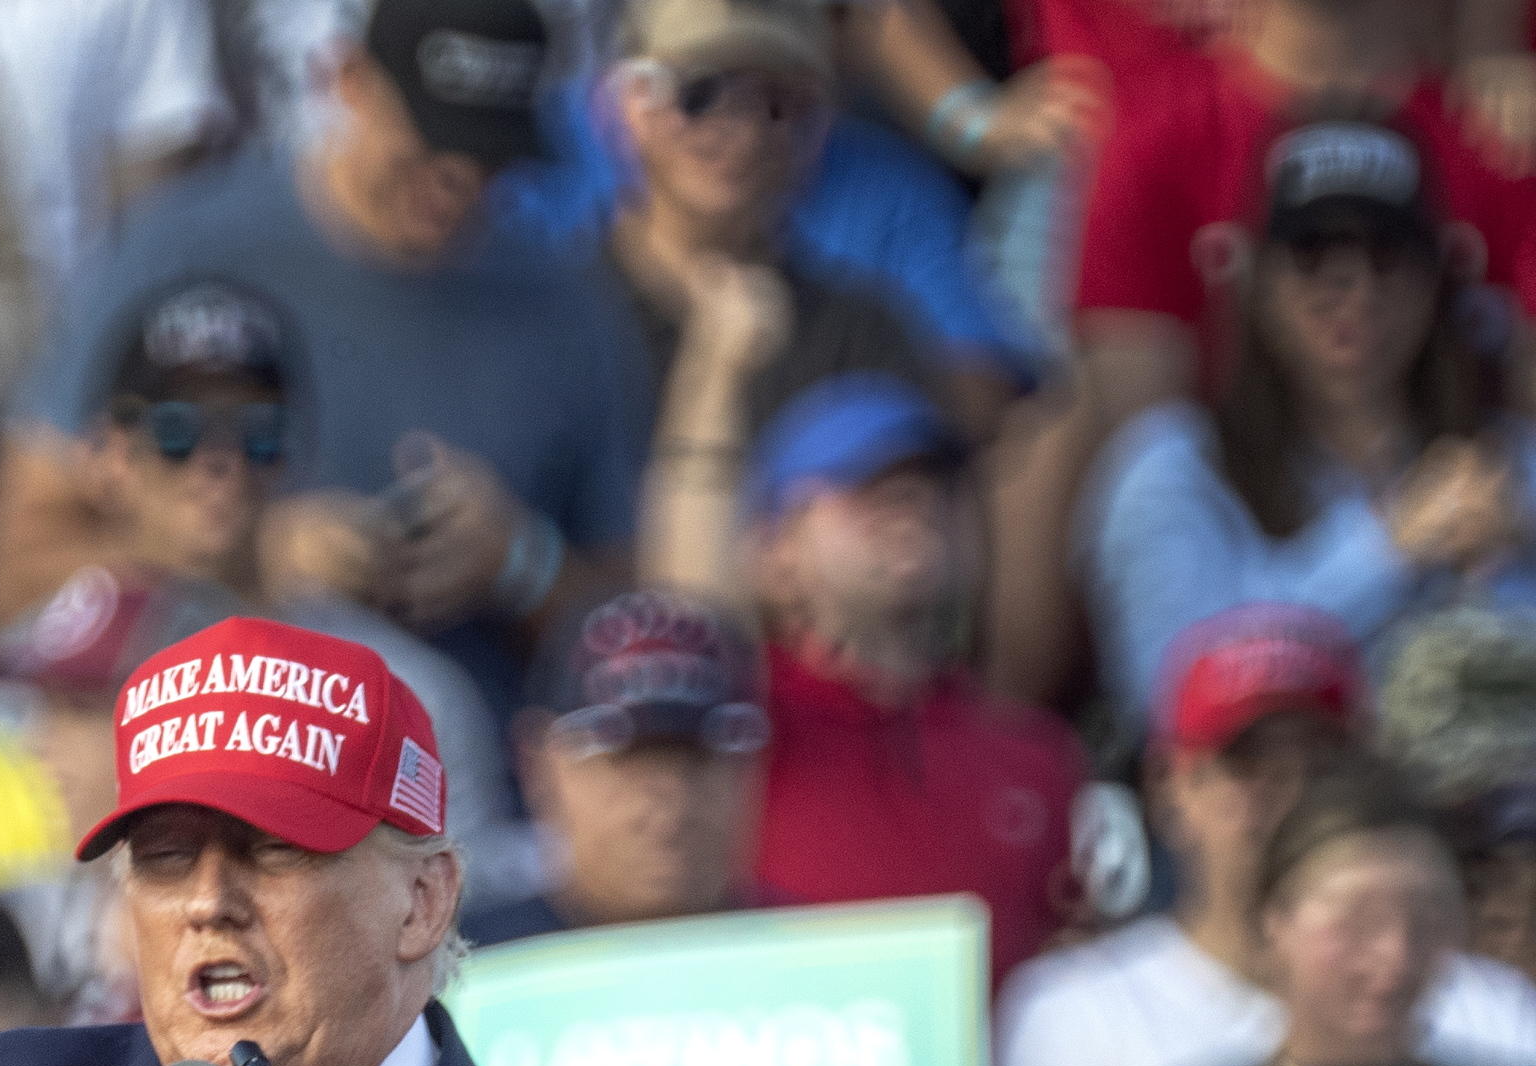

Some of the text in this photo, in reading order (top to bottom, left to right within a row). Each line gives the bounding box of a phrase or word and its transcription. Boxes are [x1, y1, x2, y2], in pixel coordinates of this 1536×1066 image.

[120, 652, 371, 727] MAKE AMERICA
[128, 710, 347, 777] GREAT AGAIN
